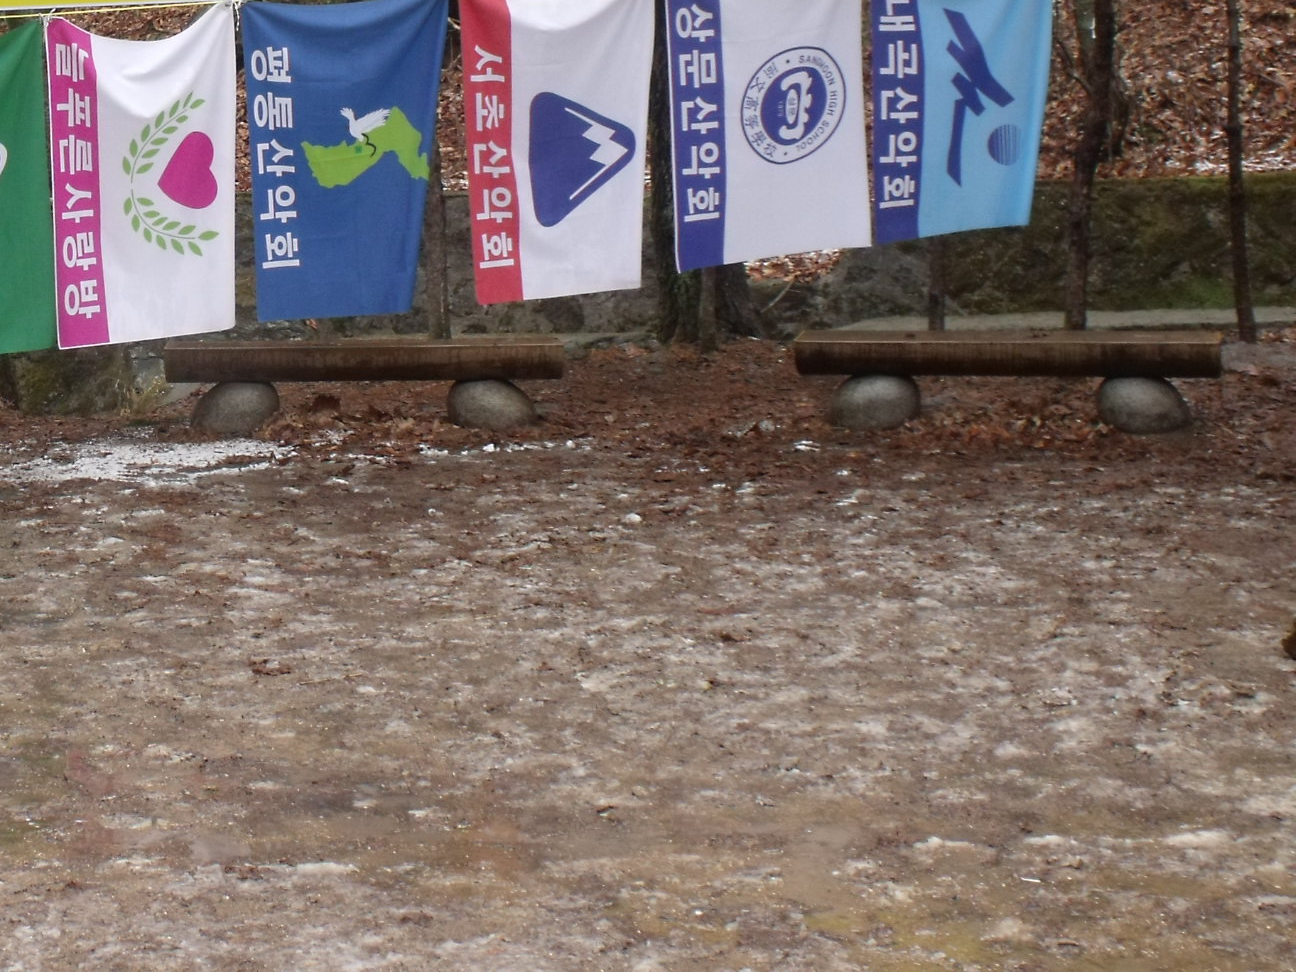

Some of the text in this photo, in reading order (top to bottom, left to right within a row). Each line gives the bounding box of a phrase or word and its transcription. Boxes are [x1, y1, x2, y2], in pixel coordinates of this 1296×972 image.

[55, 42, 101, 318] 늘푸른사랑방
[250, 46, 301, 269] 평통산악회
[470, 44, 515, 269] 서초산악회
[675, 3, 720, 223] 상문산악회
